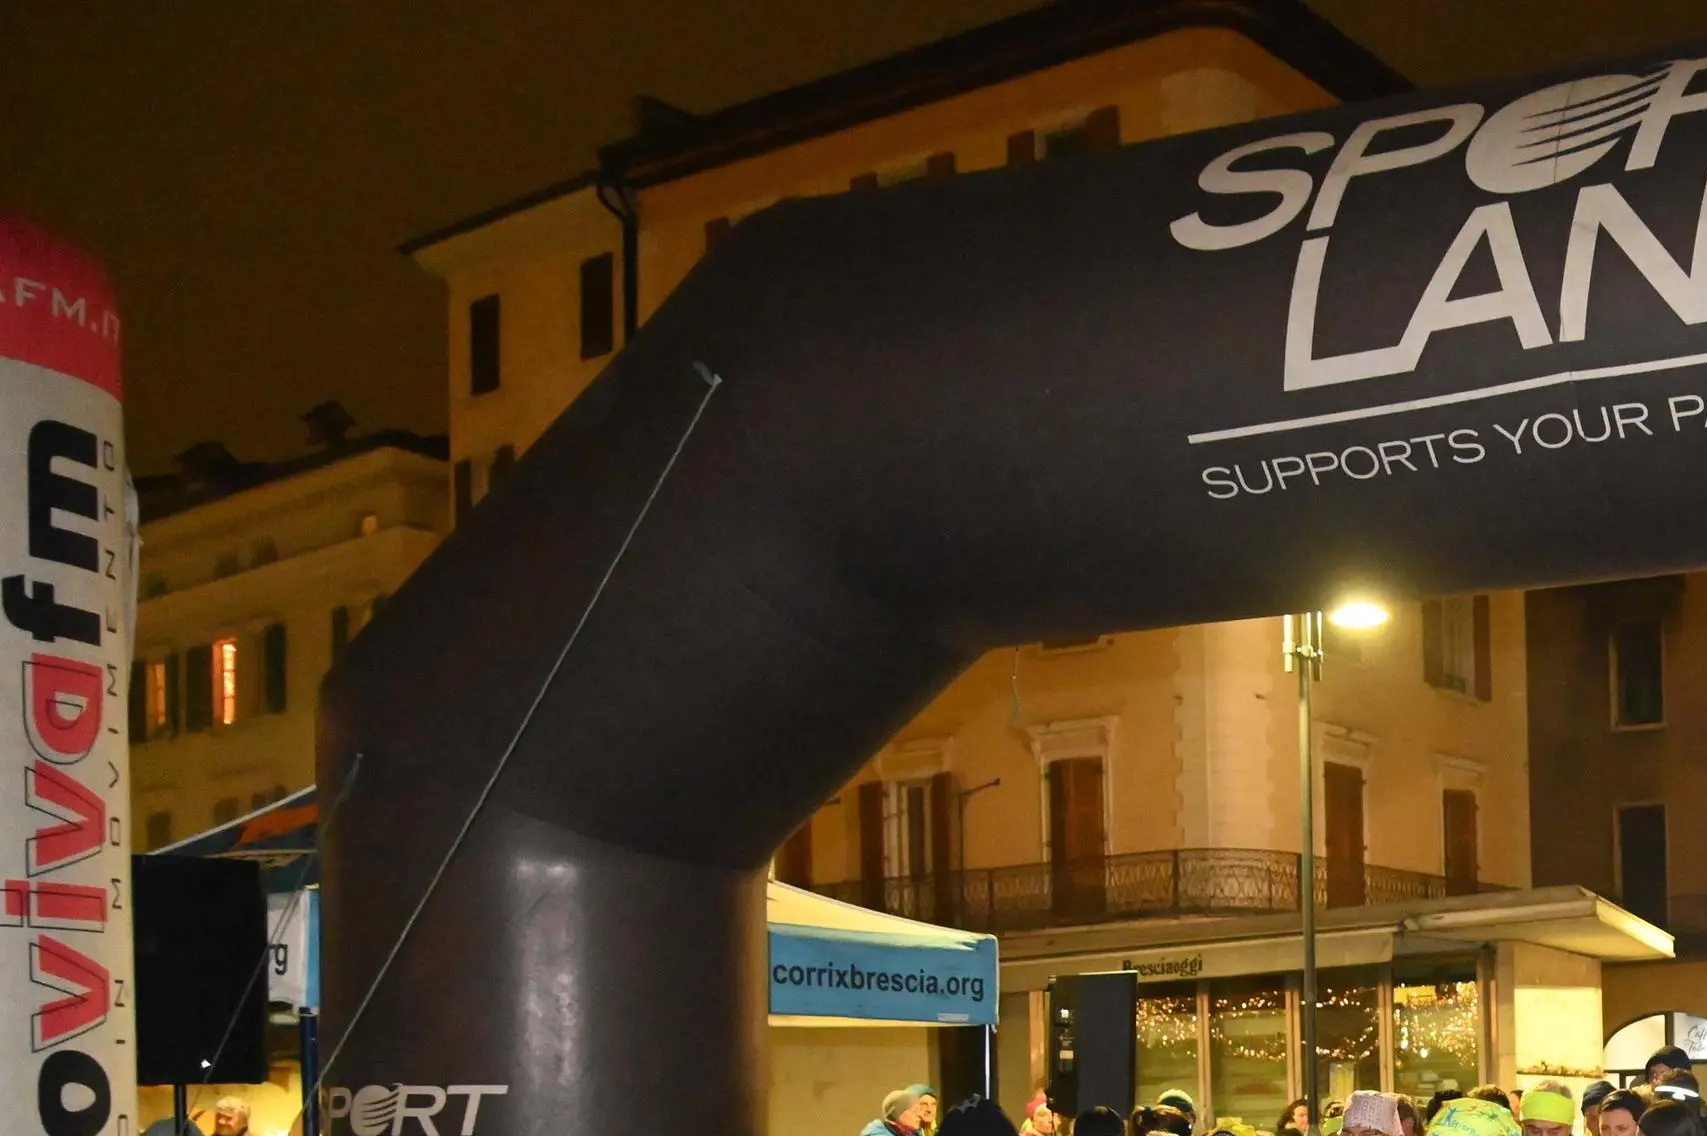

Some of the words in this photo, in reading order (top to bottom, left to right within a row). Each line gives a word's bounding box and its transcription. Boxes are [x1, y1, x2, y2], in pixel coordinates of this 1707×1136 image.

[1201, 429, 1486, 500] SUPPORTS
[1492, 401, 1654, 456] YOUR
[772, 961, 984, 1002] corrixbrescia.org
